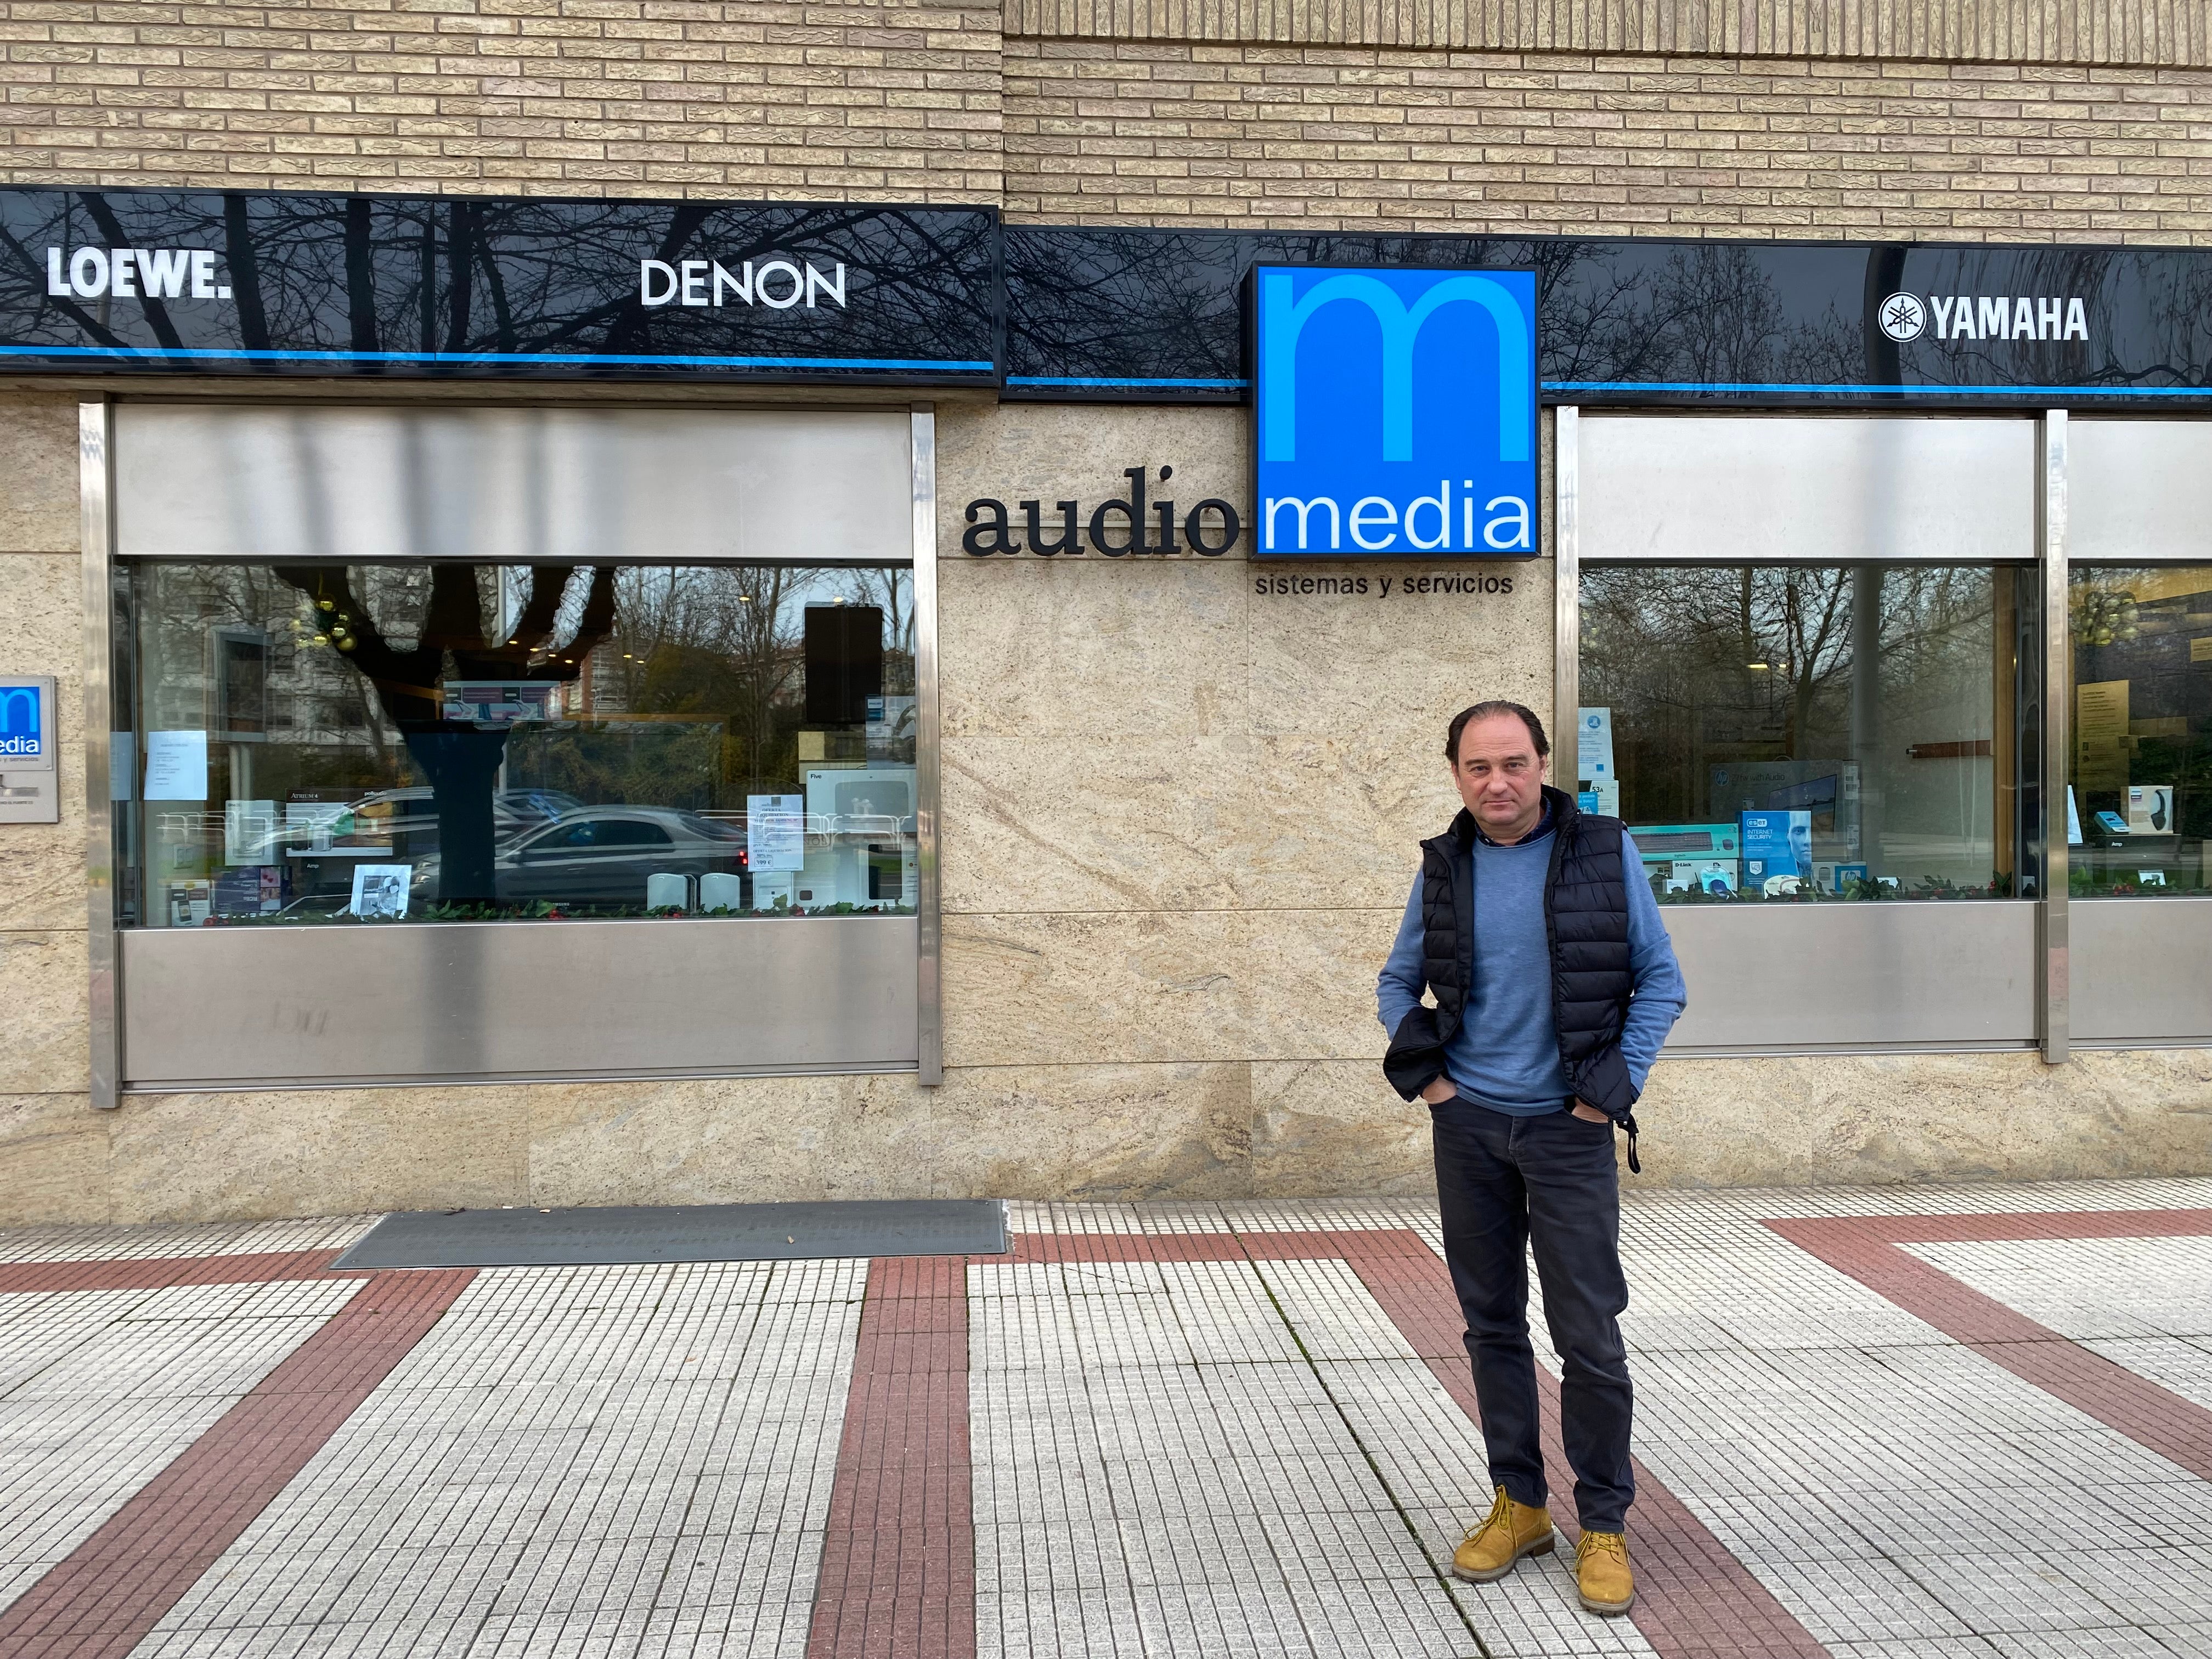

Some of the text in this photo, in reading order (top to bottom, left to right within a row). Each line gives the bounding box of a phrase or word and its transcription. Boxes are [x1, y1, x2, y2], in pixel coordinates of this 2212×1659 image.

[48, 246, 231, 298] LOEWE.
[641, 259, 845, 309] DENON
[1930, 296, 2089, 341] YAMAHA
[1265, 274, 1530, 461] m
[962, 465, 1240, 557] audio
[1265, 479, 1531, 550] media
[1255, 573, 1514, 599] sistemas y servicios
[0, 736, 39, 753] dia
[1765, 772, 1785, 781] Audio
